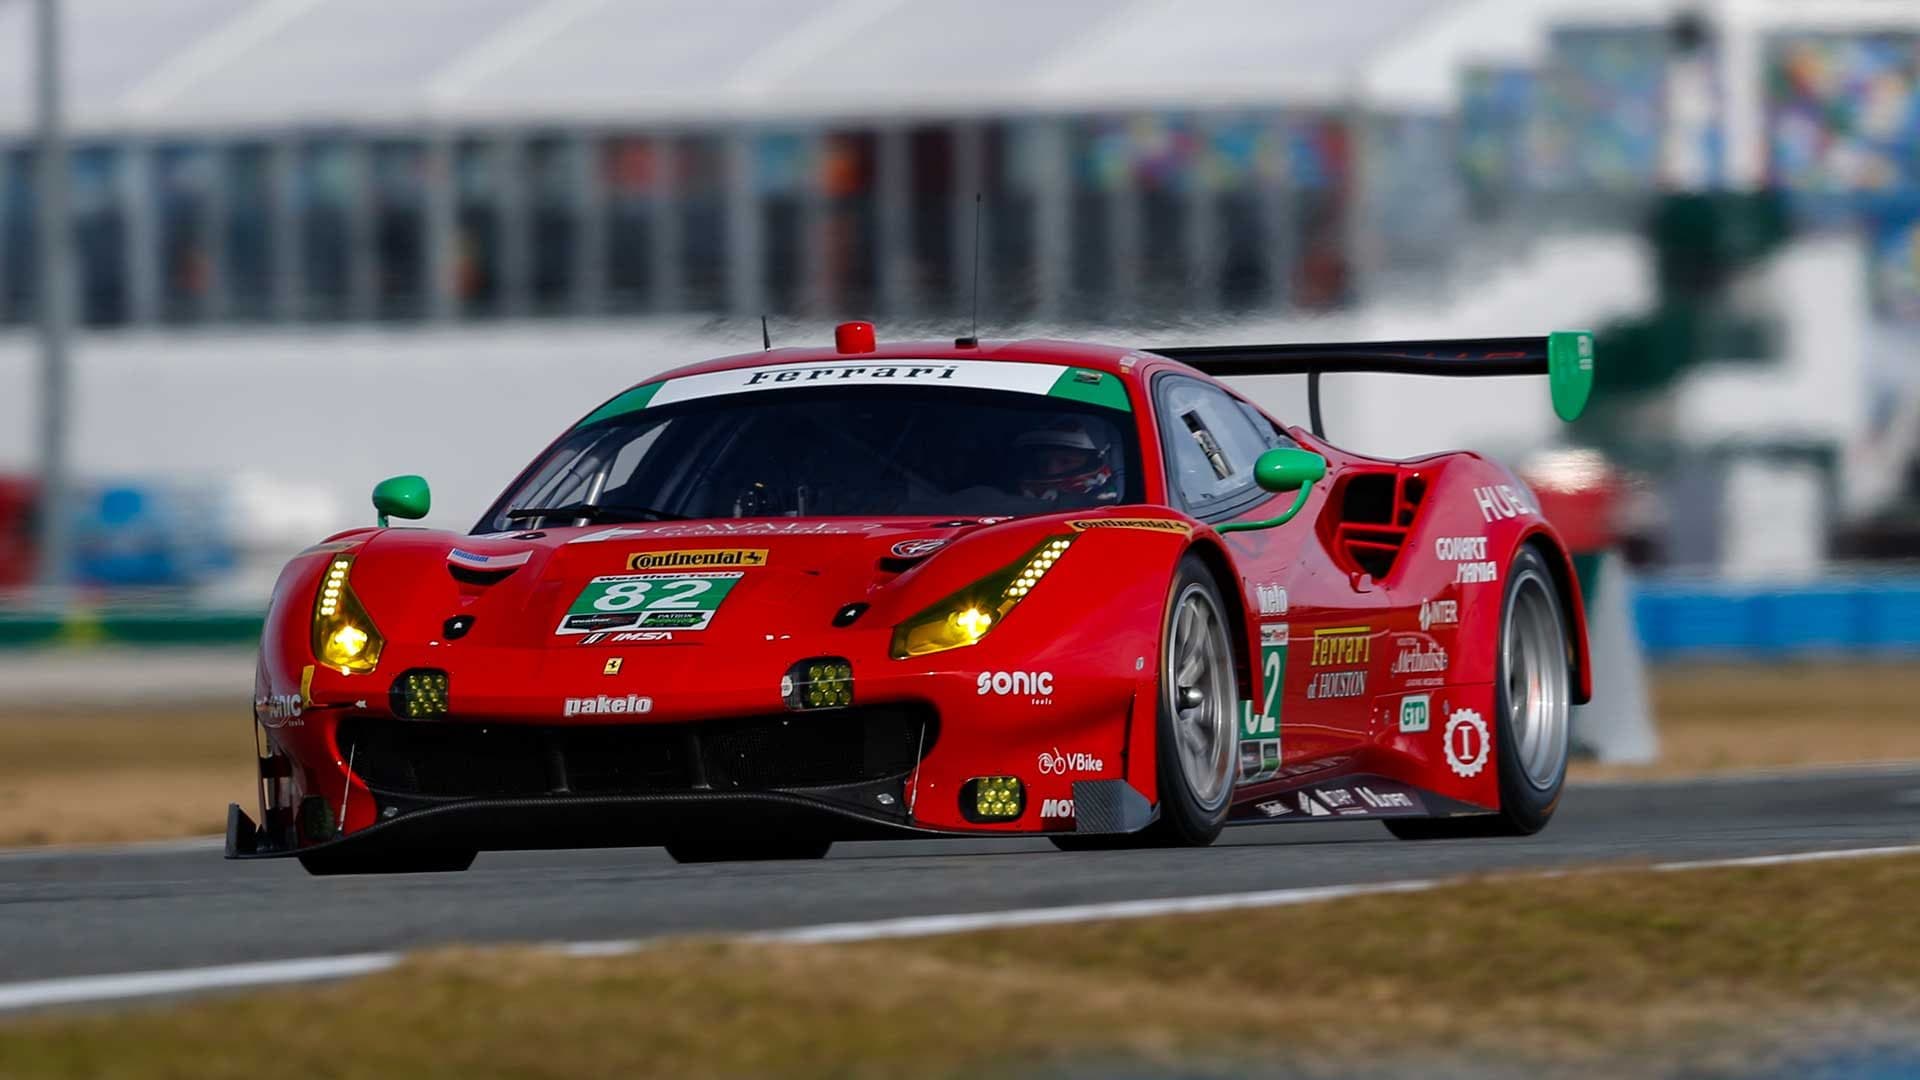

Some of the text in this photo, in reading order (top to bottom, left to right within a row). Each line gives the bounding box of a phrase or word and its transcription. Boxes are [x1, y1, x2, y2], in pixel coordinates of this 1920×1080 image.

[744, 366, 958, 386] Ferrari
[1073, 520, 1171, 530] Continental
[631, 551, 743, 570] Continental
[593, 580, 712, 611] 82
[611, 632, 673, 642] IMSA
[1311, 626, 1371, 666] Ferrari
[1318, 671, 1368, 698] HOUSTON
[564, 695, 652, 717] pakelo
[1402, 701, 1426, 726] GTD
